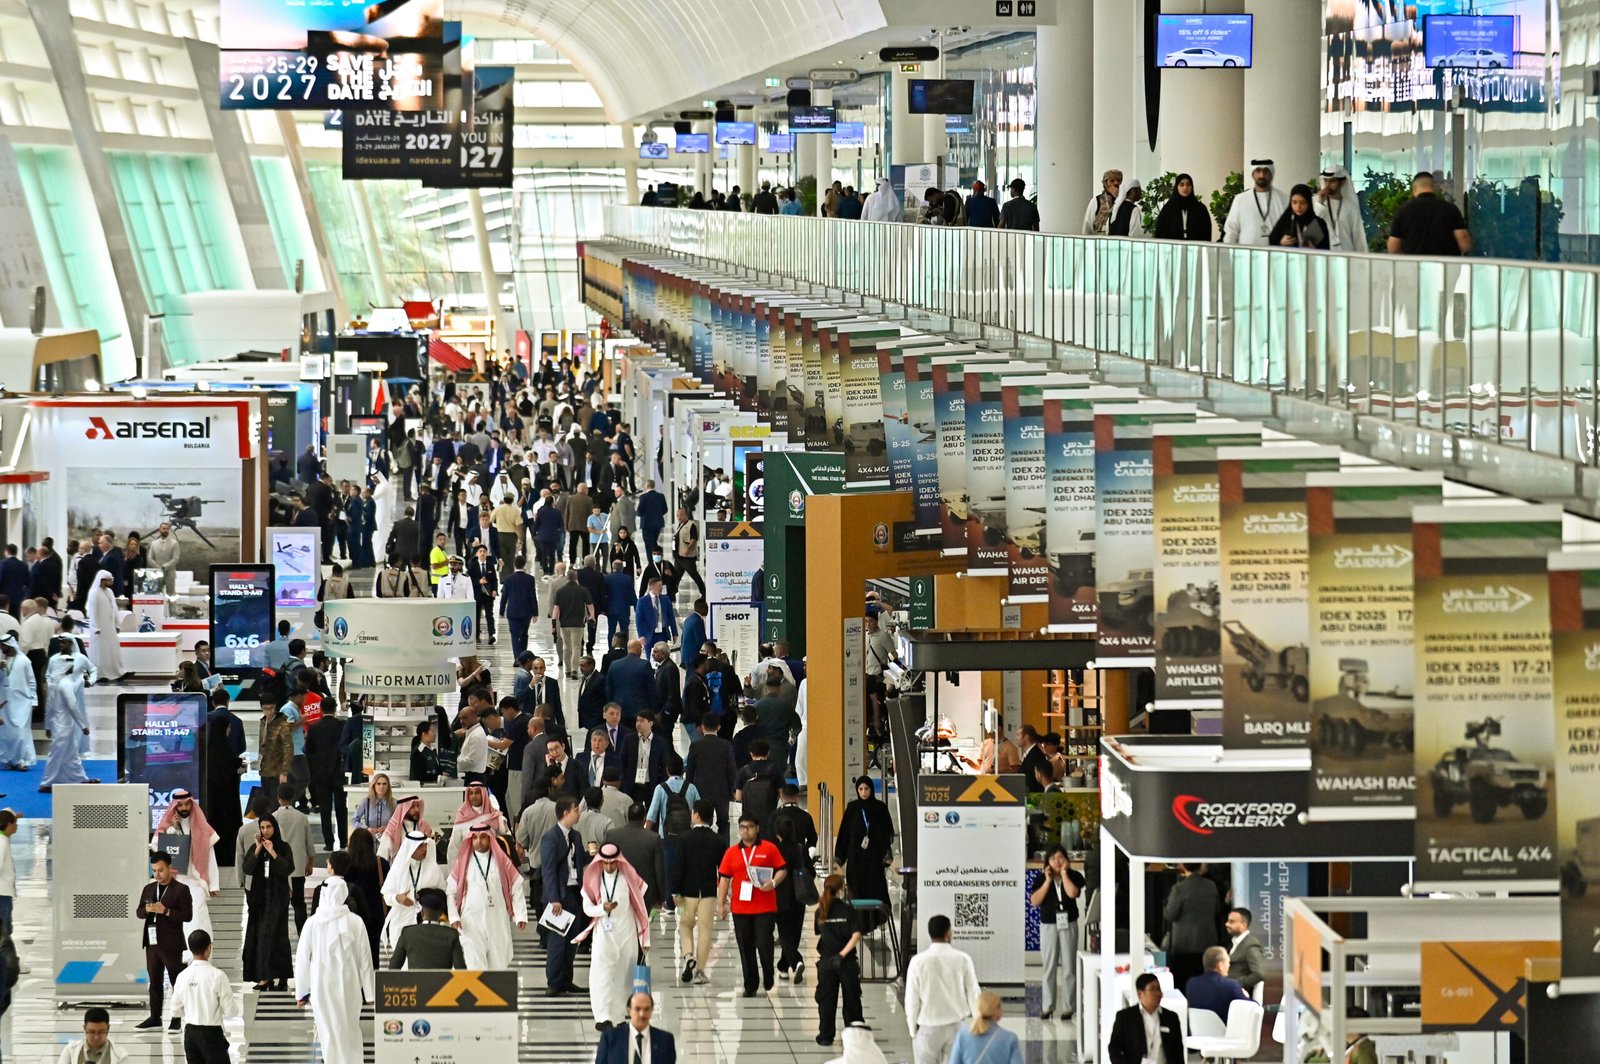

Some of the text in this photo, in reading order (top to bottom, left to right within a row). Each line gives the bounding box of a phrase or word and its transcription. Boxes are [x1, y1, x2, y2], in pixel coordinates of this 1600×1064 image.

[266, 56, 318, 74] 25-29
[326, 54, 374, 71] SAVE
[340, 69, 374, 86] THE
[229, 75, 316, 101] 2027
[327, 84, 374, 100] DATE
[355, 114, 391, 126] DATE
[405, 134, 453, 150] 2027
[461, 132, 503, 144] YOU IN
[355, 157, 452, 165] idexuae.ae navdex.ae
[116, 416, 210, 438] arsenal
[892, 440, 911, 448] B-25
[917, 453, 936, 461] B-25
[858, 466, 872, 474] 4X4
[1012, 466, 1032, 474] IDEX
[1053, 486, 1095, 494] IDEX 202
[1130, 508, 1154, 516] 2025
[1162, 537, 1217, 546] IDEX 2025
[1162, 548, 1184, 556] ABU
[1230, 571, 1291, 581] IDEX 2025
[1230, 583, 1291, 591] ABU DHABI
[1319, 595, 1363, 603] DEFENCE
[1071, 604, 1091, 612] 4X4
[1442, 600, 1510, 613] CALIDUS
[725, 613, 750, 621] SHOT
[1320, 610, 1351, 621] IDEX
[1356, 610, 1387, 621] 2025
[1320, 623, 1387, 632] ABU DHABI
[225, 634, 259, 649] 6x6
[1099, 636, 1151, 646] 4X4 MATV
[1424, 632, 1498, 642] INNOVATIVE
[1425, 644, 1475, 654] DEFENCE
[1165, 664, 1217, 675] WAHASH
[1426, 660, 1551, 674] IDEX 2025 17-21
[361, 674, 450, 686] INFORMATION
[1426, 675, 1501, 685] ABU DHABI
[145, 720, 178, 728] HALL: 11
[1244, 721, 1284, 736] BARQ
[131, 728, 190, 736] STAND: 11-A47
[1315, 776, 1384, 791] WAHASH
[925, 792, 950, 802] 2025
[1195, 802, 1297, 815] ROCKFORD
[1199, 815, 1288, 828] XELLERIX
[1427, 846, 1552, 862] TACTICAL 4X4
[960, 866, 988, 875] منظمين
[989, 866, 1009, 875] مكتب
[1440, 987, 1474, 997] C6-001
[384, 994, 417, 1007] 2025
